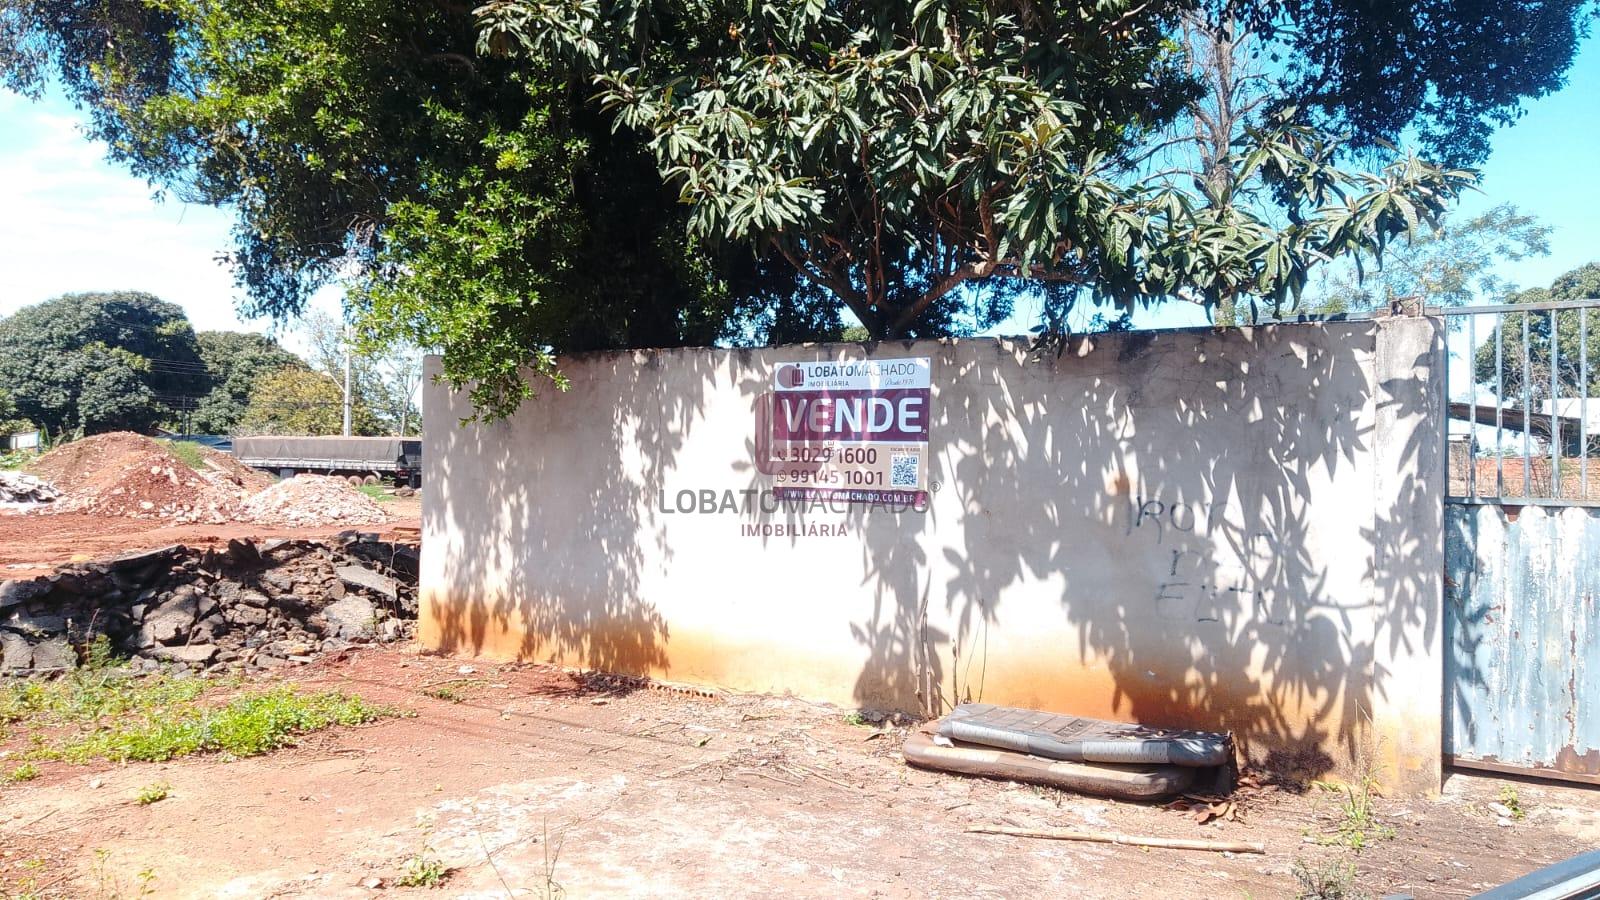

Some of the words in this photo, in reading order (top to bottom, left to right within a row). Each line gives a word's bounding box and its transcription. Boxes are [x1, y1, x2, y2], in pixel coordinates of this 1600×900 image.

[808, 363, 914, 378] LOBATOMACHADO
[781, 397, 923, 433] VENDE
[790, 447, 831, 464] 3029
[838, 448, 877, 465] 1600
[791, 469, 839, 484] 99145
[845, 471, 883, 486] 1001
